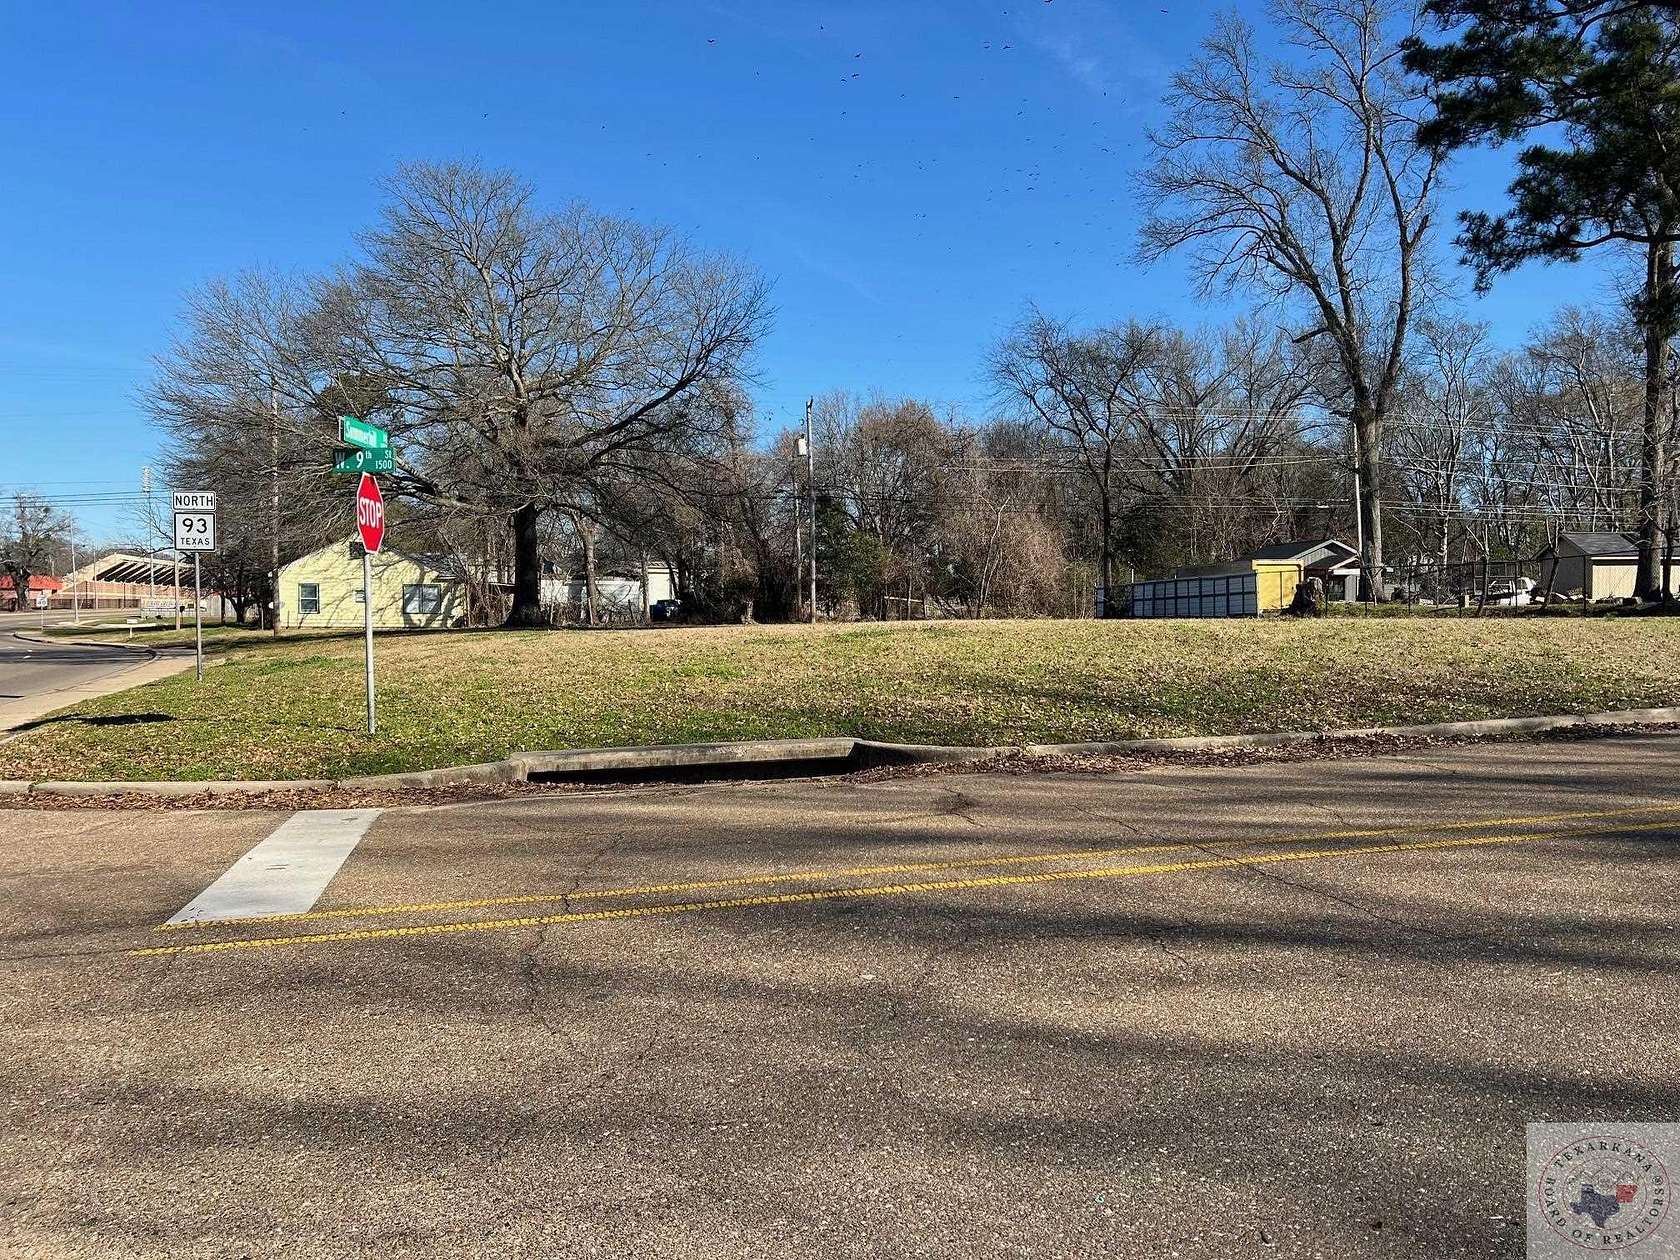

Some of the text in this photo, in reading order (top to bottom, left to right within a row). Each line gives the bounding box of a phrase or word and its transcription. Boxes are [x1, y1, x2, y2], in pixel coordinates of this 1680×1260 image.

[375, 460, 392, 469] 1500
[175, 495, 213, 507] NORTH
[359, 496, 382, 529] STOP
[182, 517, 208, 534] 93
[180, 537, 210, 546] TEXAS
